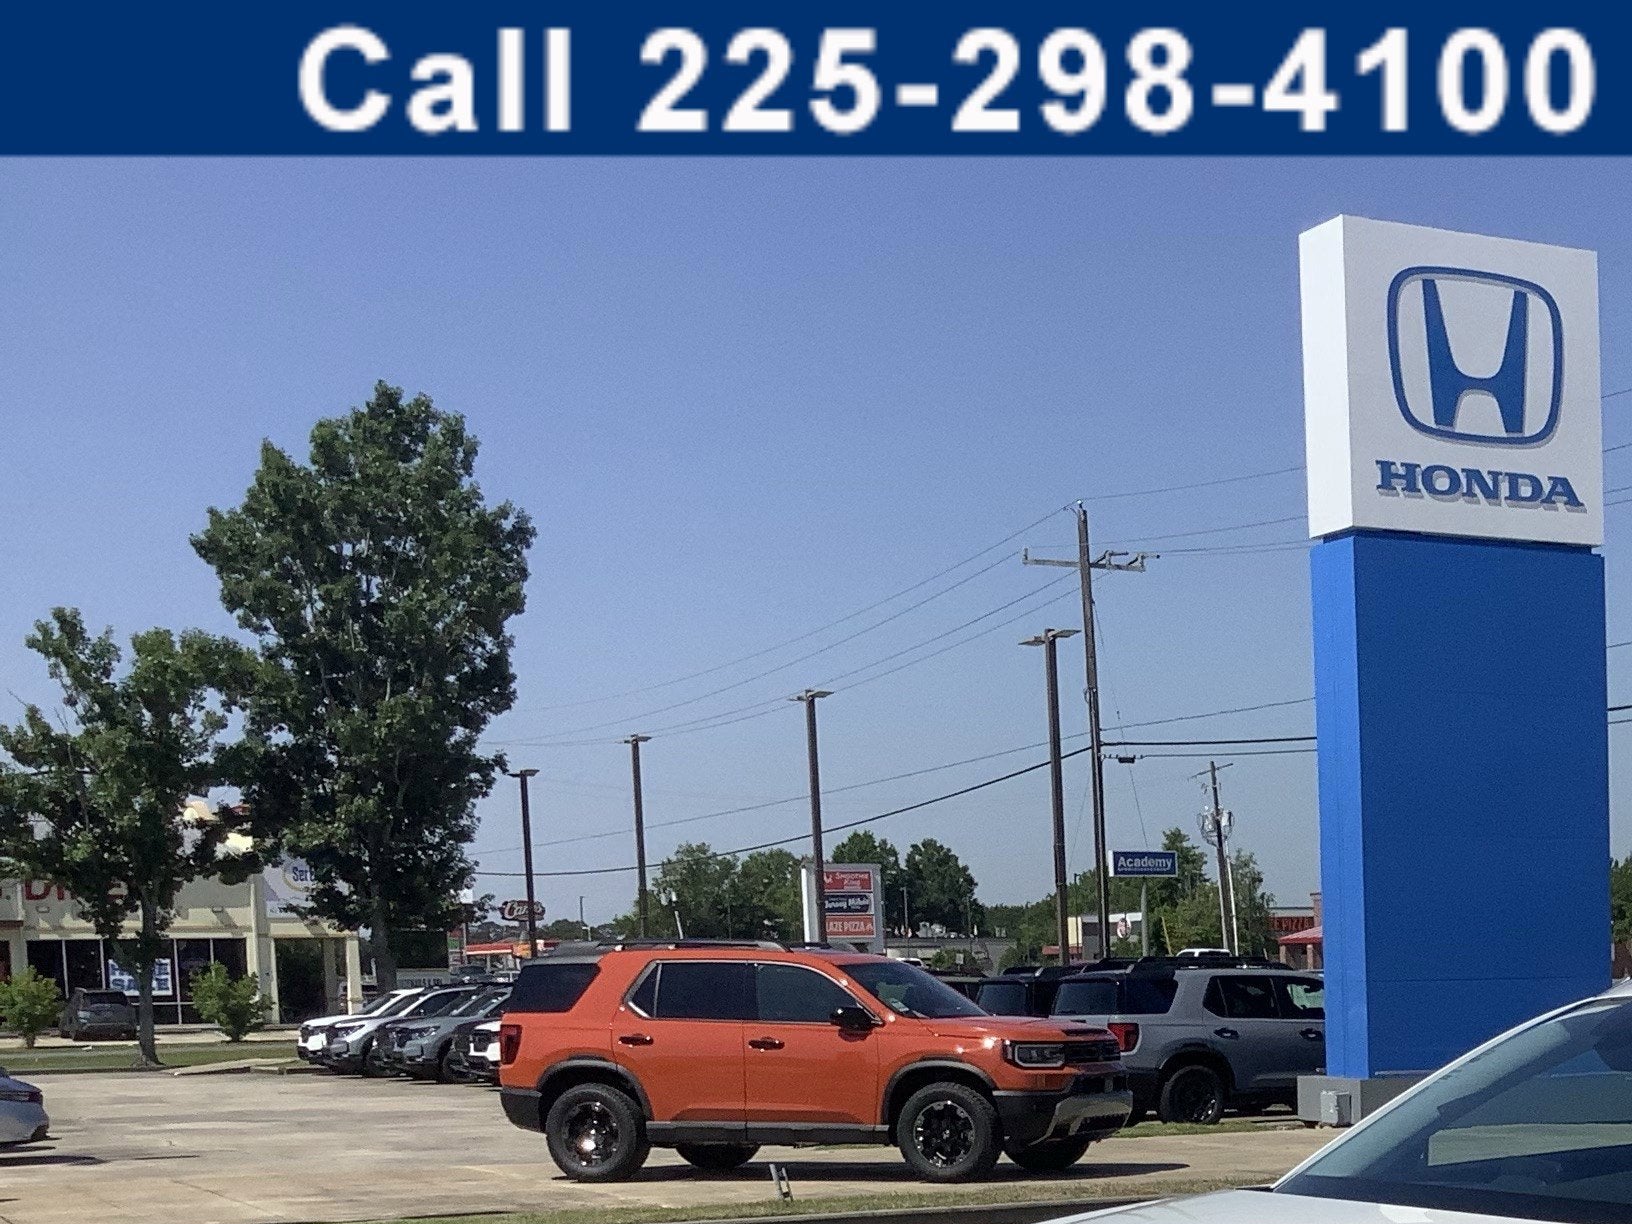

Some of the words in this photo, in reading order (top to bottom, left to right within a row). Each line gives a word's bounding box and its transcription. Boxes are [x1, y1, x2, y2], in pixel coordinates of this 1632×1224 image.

[1375, 460, 1586, 512] HONDA
[1117, 856, 1173, 870] Academy
[843, 921, 865, 932] PIZZA
